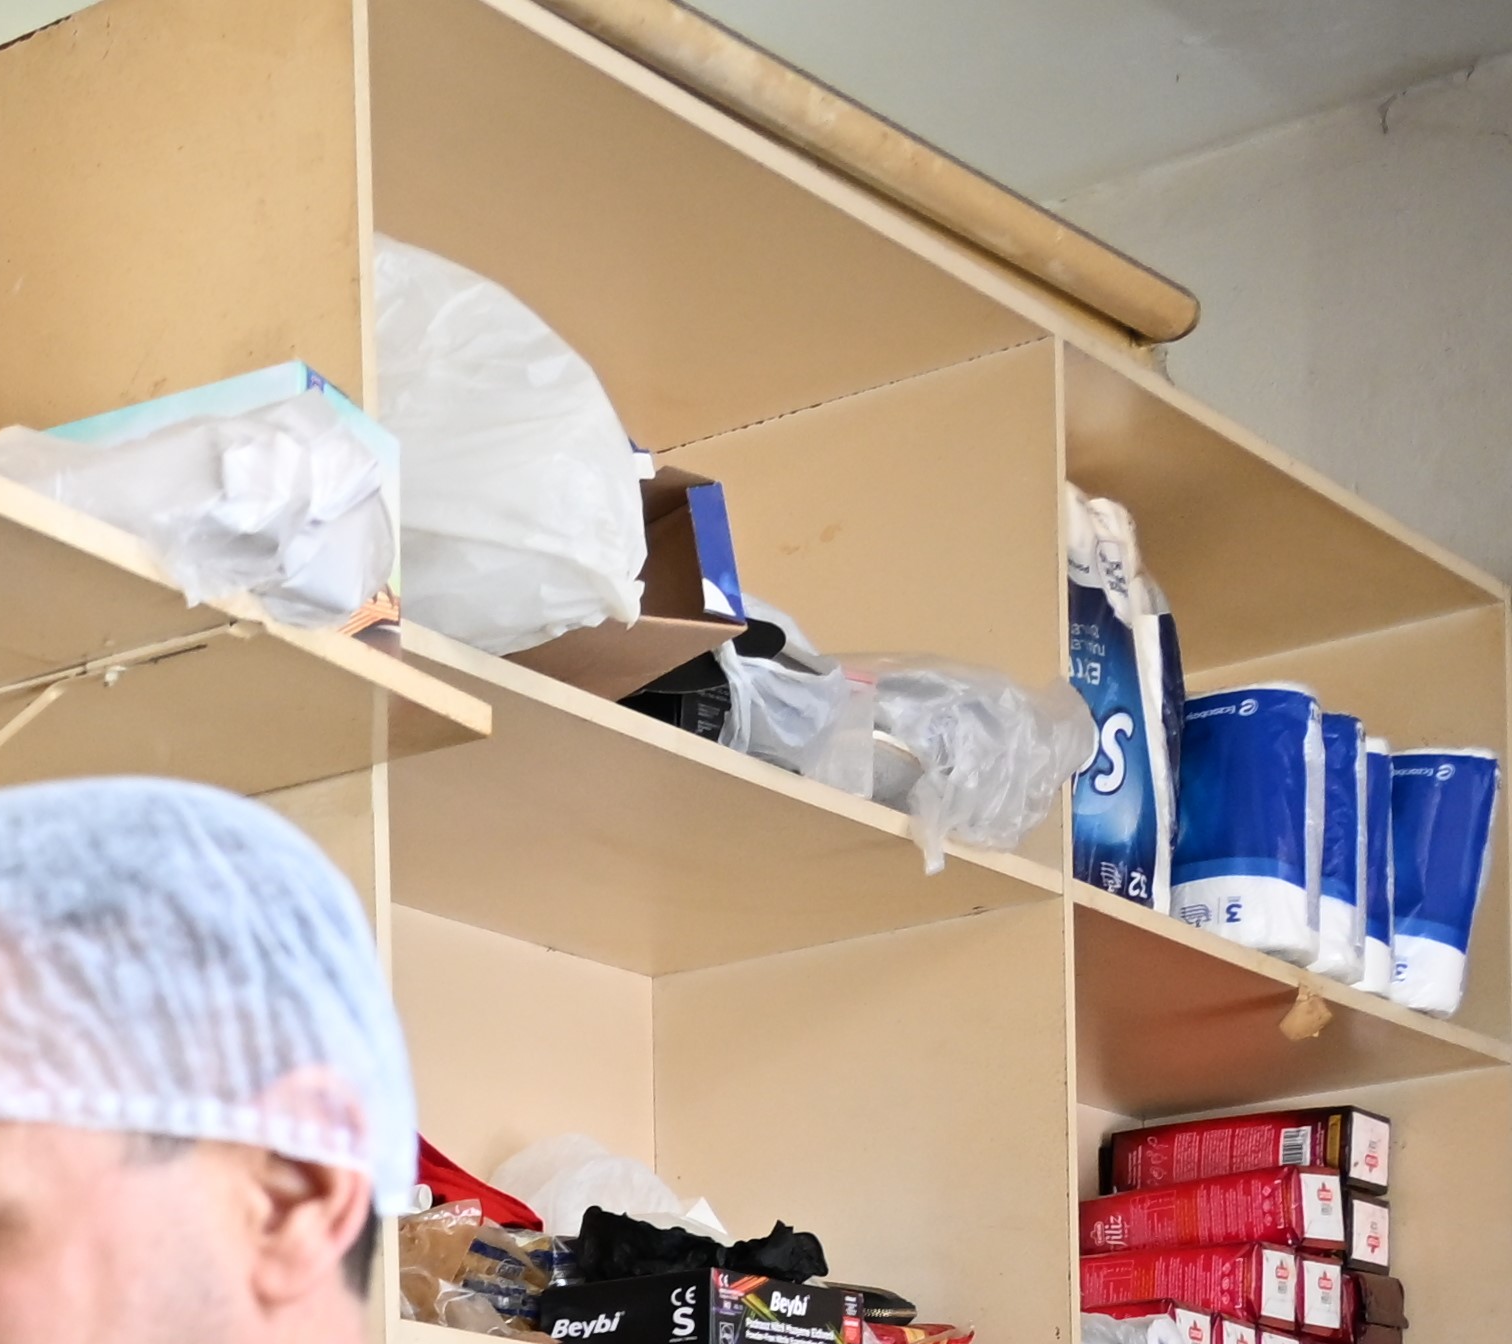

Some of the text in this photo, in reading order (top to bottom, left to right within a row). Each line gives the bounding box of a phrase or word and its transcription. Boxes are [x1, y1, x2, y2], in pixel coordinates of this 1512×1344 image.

[1128, 871, 1148, 899] 32
[1225, 904, 1243, 924] 3
[770, 1291, 808, 1317] Beybi
[551, 1314, 621, 1340] Beybi
[671, 1306, 696, 1337] S
